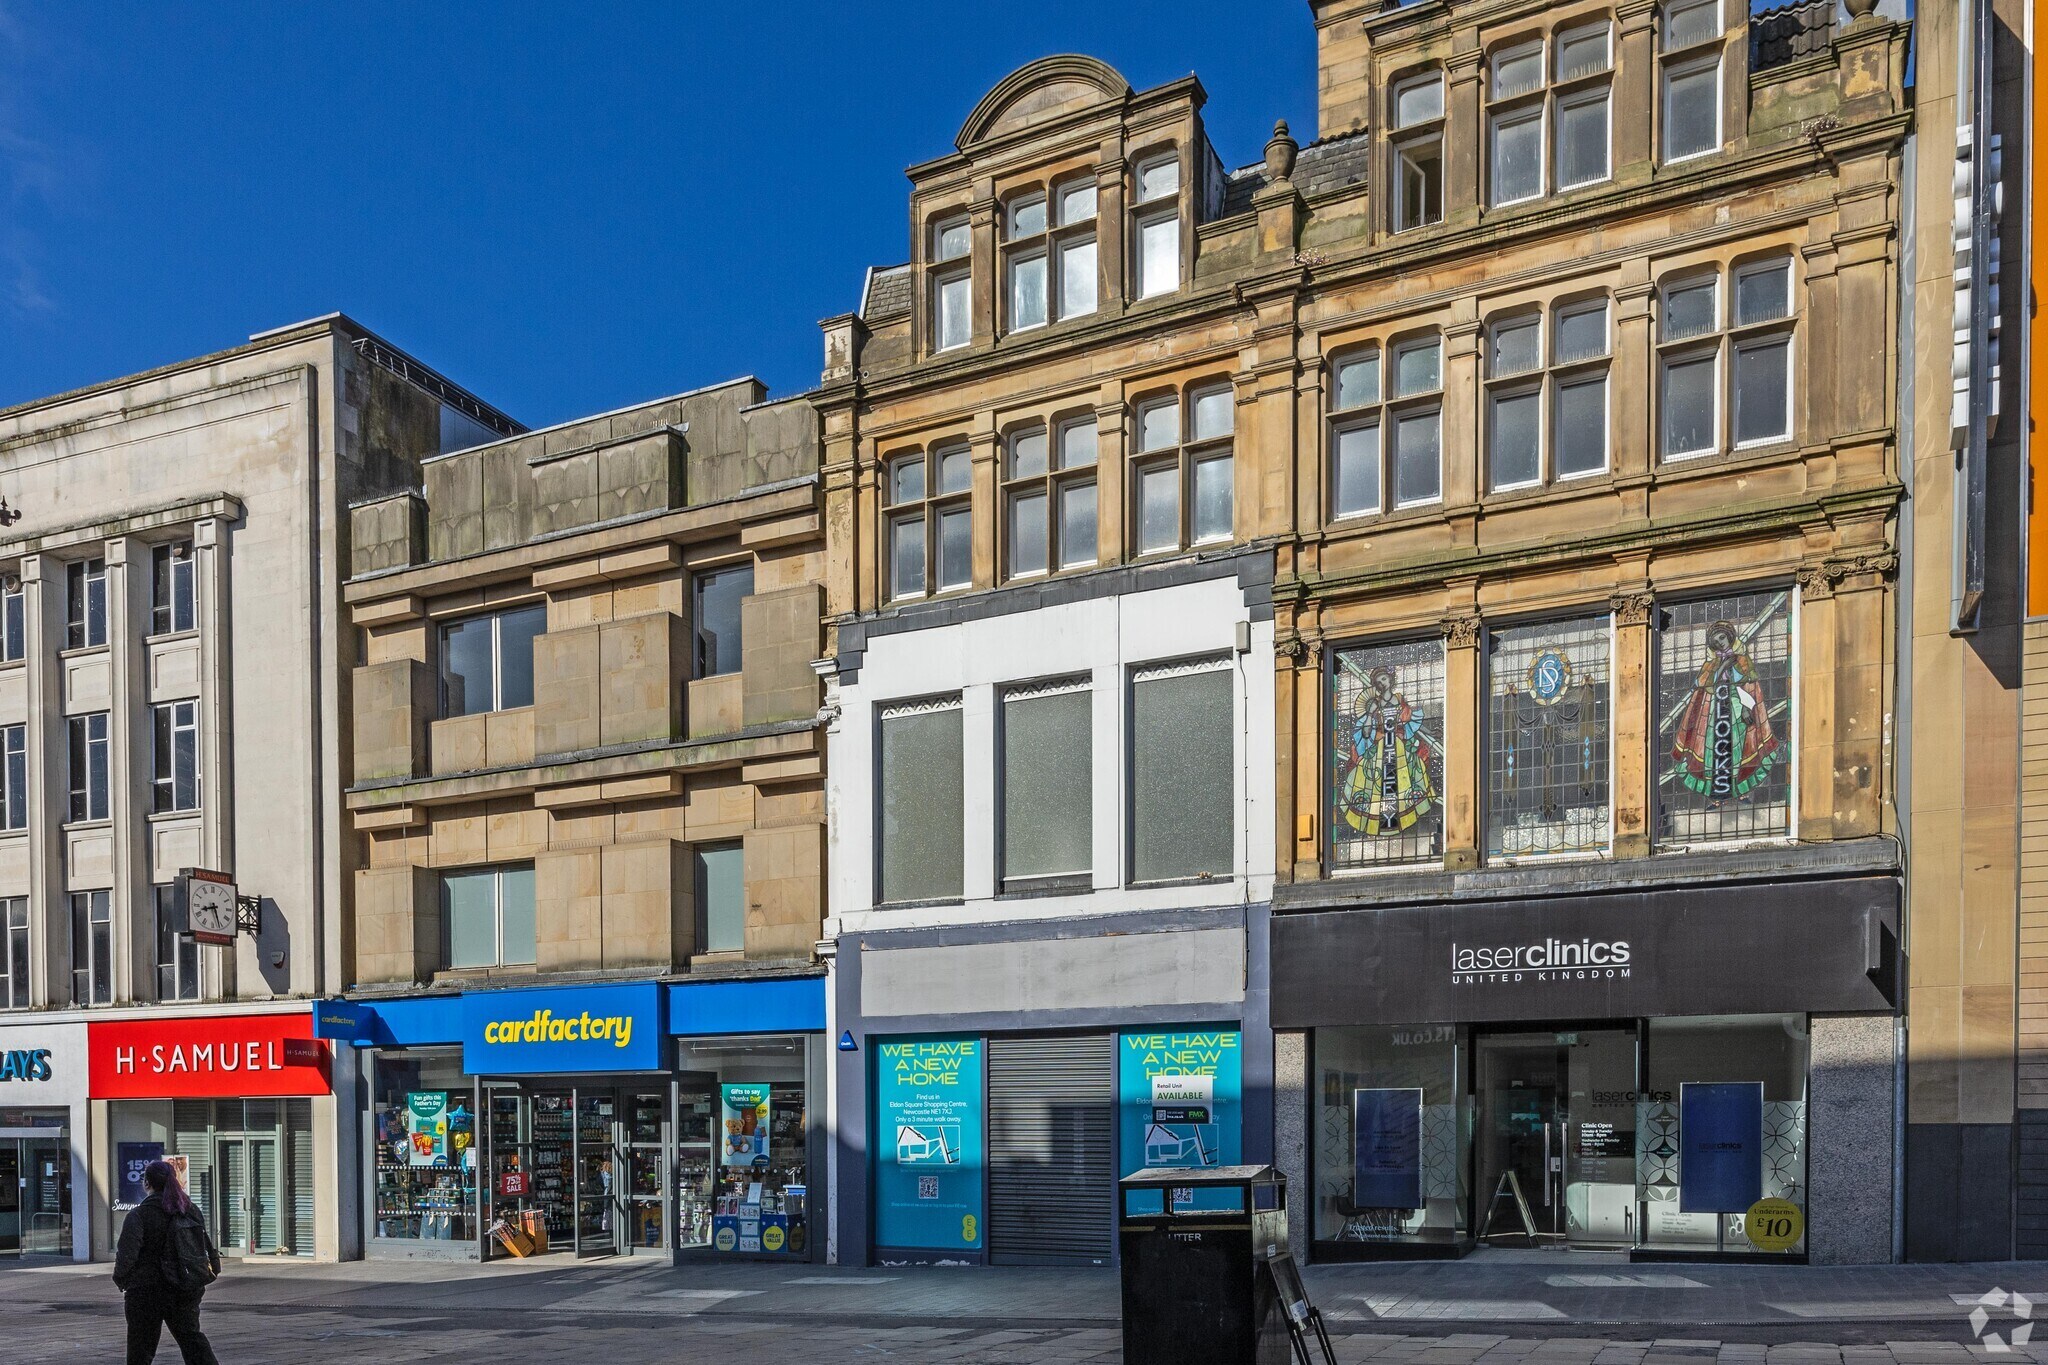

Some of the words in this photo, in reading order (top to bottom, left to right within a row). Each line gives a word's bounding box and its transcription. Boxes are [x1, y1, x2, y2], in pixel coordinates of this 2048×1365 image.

[1713, 684, 1731, 794] CLOCKS
[1381, 716, 1398, 828] CUTLERY
[1452, 973, 1522, 984] UNITED
[1538, 968, 1630, 981] KINGDOM
[321, 1016, 356, 1026] cardfactory
[484, 1009, 632, 1048] cardfactory
[882, 1044, 916, 1057] WE
[920, 1042, 975, 1056] HAVE
[1127, 1036, 1166, 1050] WE
[1171, 1034, 1237, 1048] HAVE
[0, 1048, 52, 1082] AYS
[895, 1059, 910, 1071] A
[914, 1058, 962, 1070] NEW
[1142, 1051, 1160, 1065] A
[1164, 1050, 1222, 1064] NEW
[898, 1072, 958, 1086] HOME
[1157, 1092, 1203, 1100] AVAILABLE
[506, 1174, 521, 1186] 75%
[506, 1184, 522, 1193] SALE
[1757, 1218, 1792, 1237] £10
